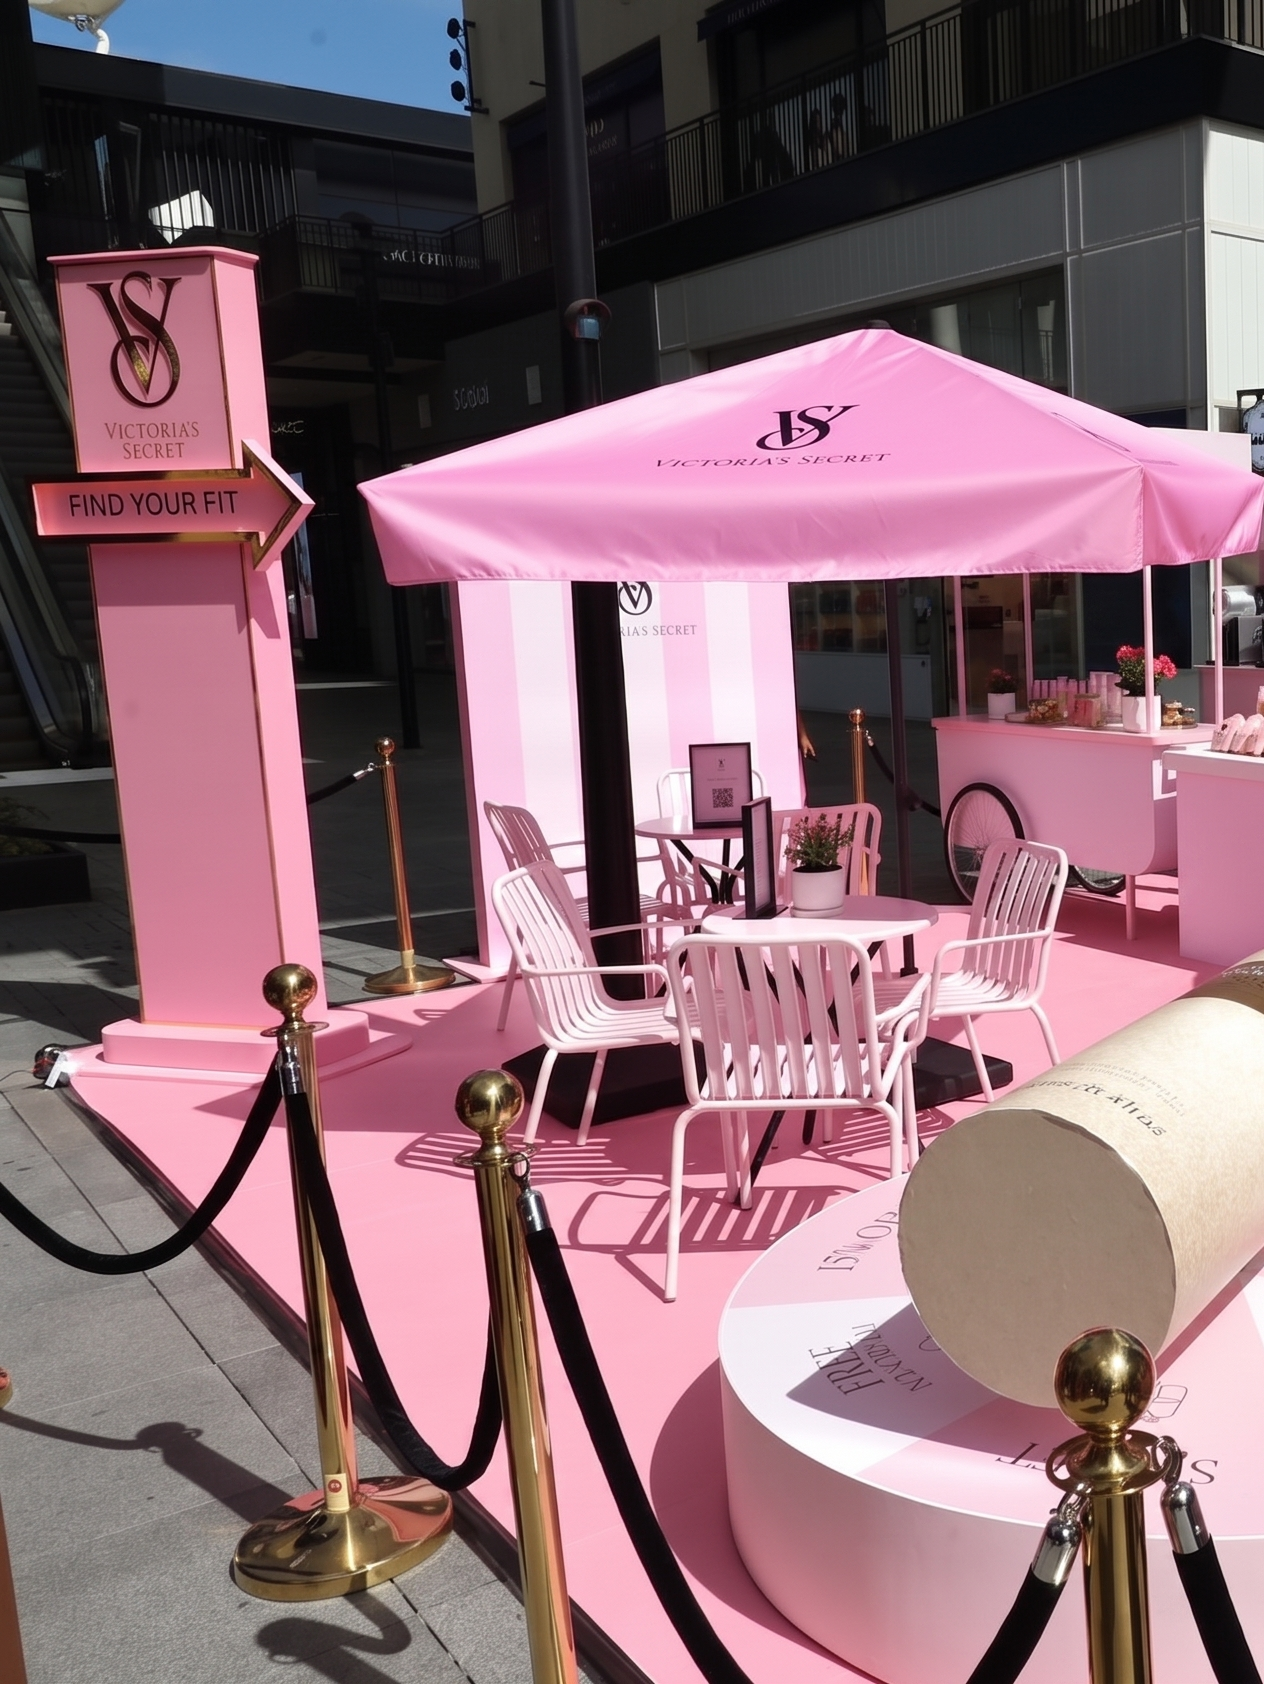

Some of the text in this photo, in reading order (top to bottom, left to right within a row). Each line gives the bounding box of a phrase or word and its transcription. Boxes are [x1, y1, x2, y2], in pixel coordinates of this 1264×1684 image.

[104, 421, 200, 440] VICTORIA'S
[123, 443, 185, 460] SECRET
[656, 453, 891, 468] VICTORIA'S SECRET
[69, 490, 239, 517] FIND YOUR FIT
[620, 625, 697, 637] RIA'S SECRET
[808, 1341, 885, 1396] FREE
